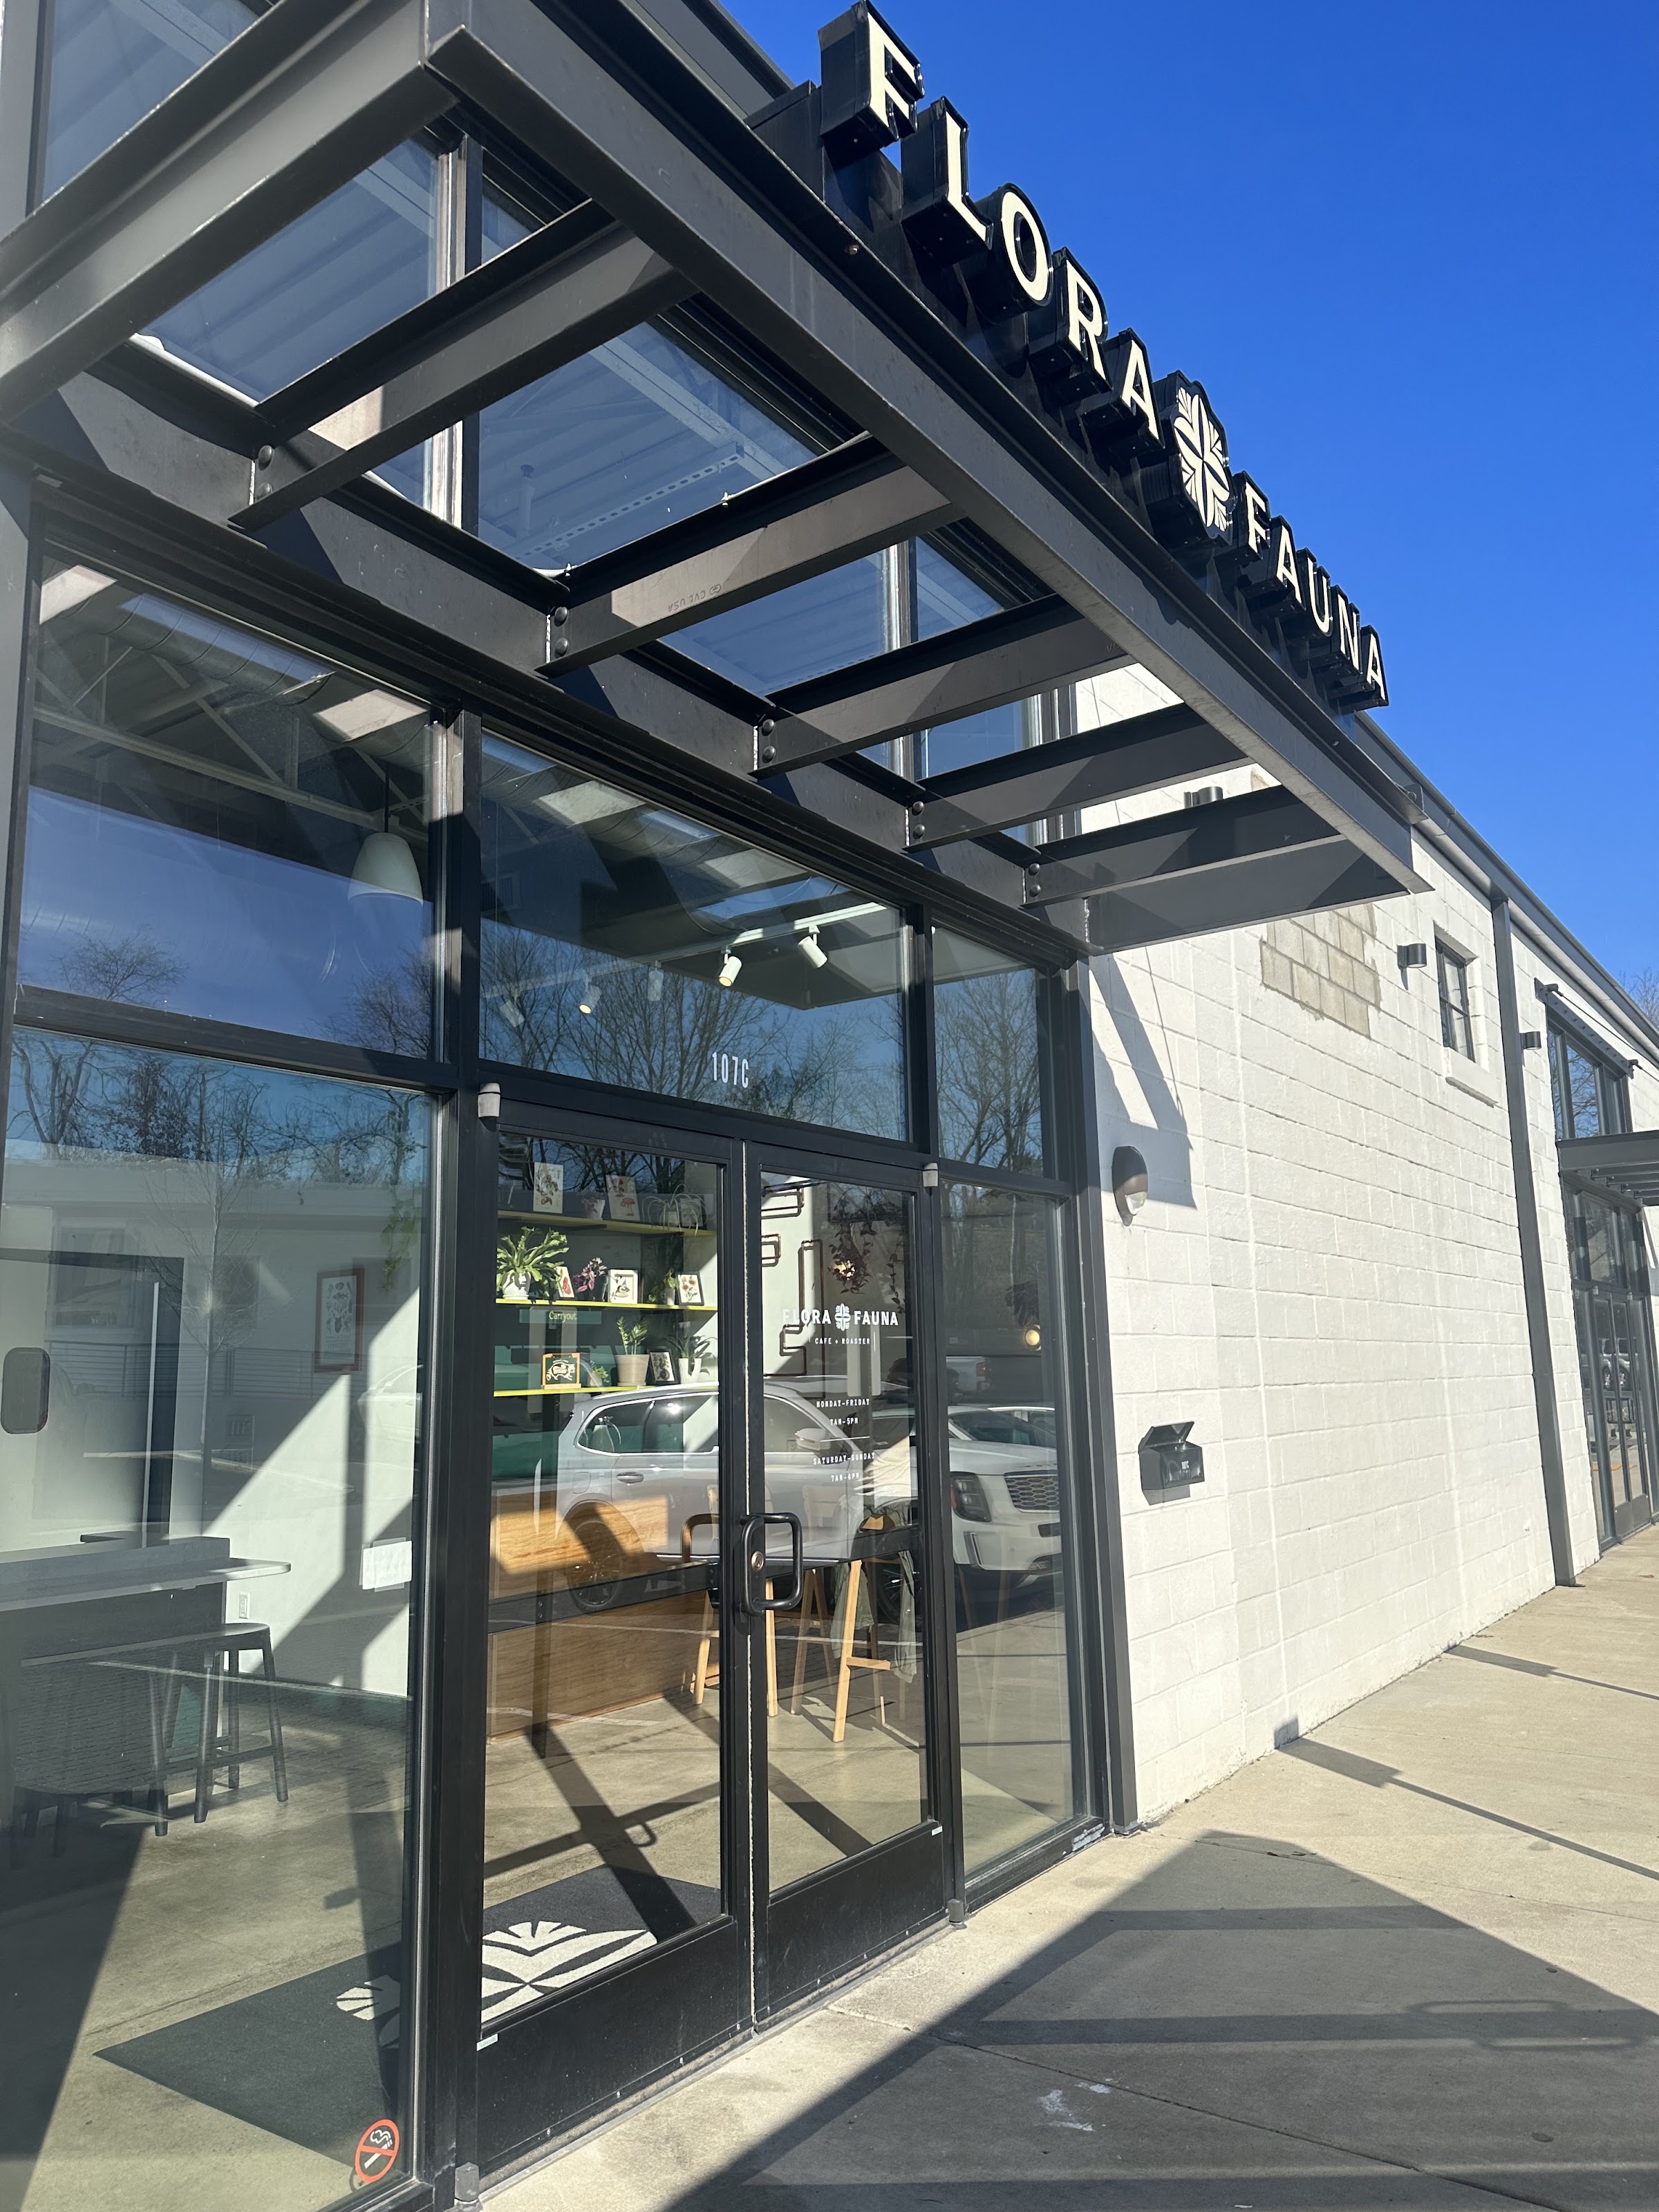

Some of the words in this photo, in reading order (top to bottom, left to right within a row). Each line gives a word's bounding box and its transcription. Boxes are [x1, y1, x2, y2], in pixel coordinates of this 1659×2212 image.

[866, 11, 1157, 438] FLORA
[1244, 481, 1385, 702] FAUNA
[712, 1051, 749, 1088] 107C
[549, 1311, 577, 1323] Carryout
[782, 1309, 832, 1325] FLORA
[854, 1310, 899, 1326] FAUNA
[816, 1398, 870, 1408] MONDAY-FRIDAY
[830, 1417, 859, 1426] 7AM-5PM
[813, 1452, 875, 1465] SATURDAY-SUNDAY
